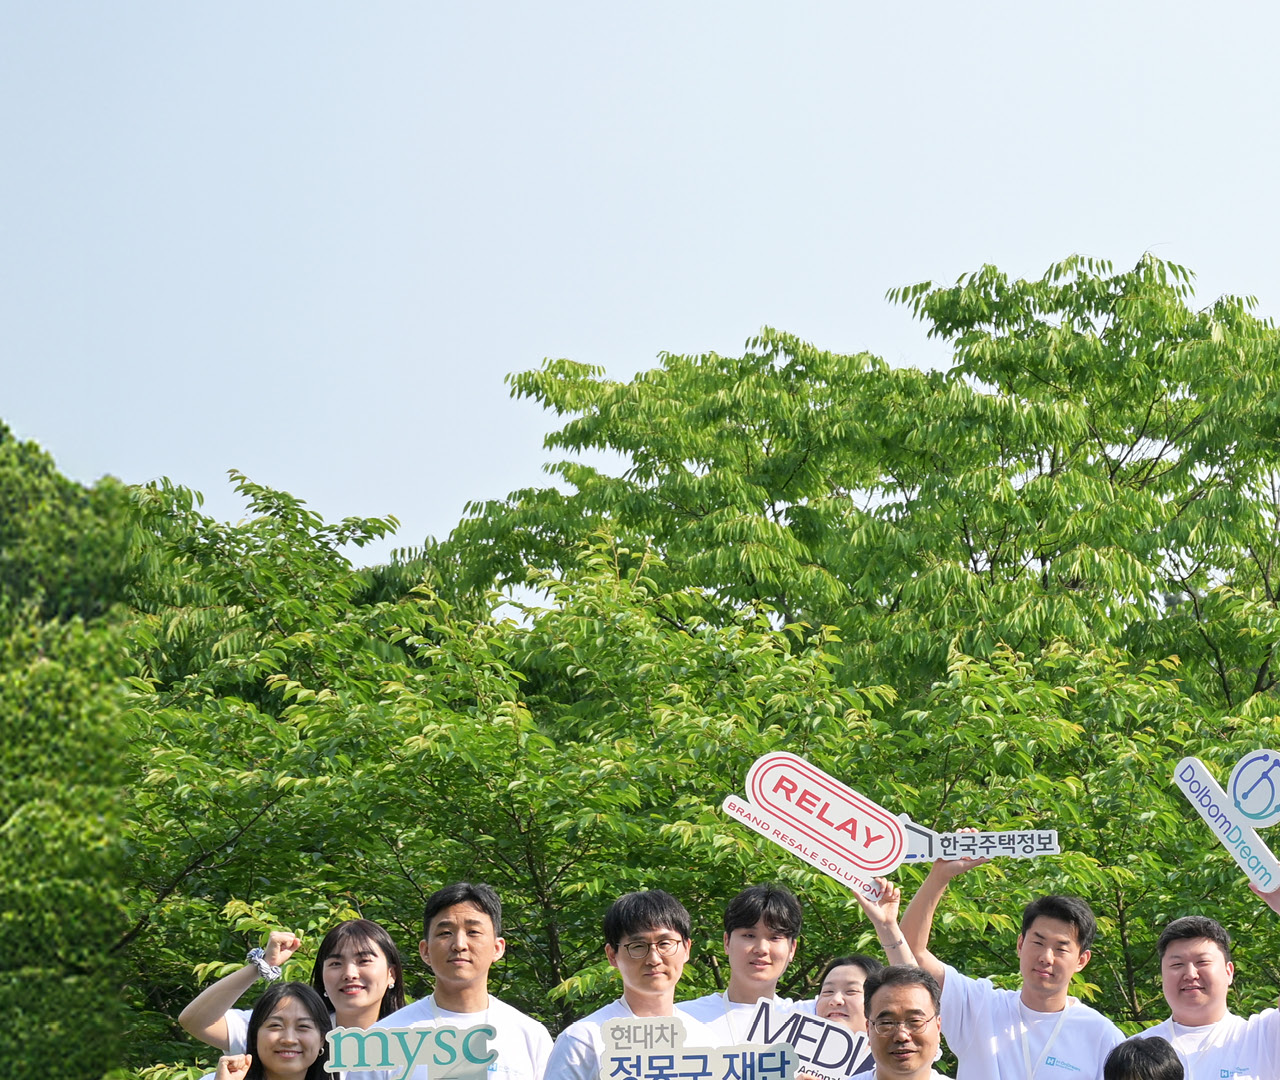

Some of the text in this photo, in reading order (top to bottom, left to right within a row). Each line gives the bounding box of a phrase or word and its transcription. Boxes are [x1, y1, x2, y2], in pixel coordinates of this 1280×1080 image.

[727, 802, 881, 898] BRAND RESALE SOLUTION
[772, 775, 884, 850] RELAY
[940, 833, 1056, 856] 한국주택정보
[1179, 764, 1273, 887] DolbomDream
[610, 1023, 678, 1049] 현대차
